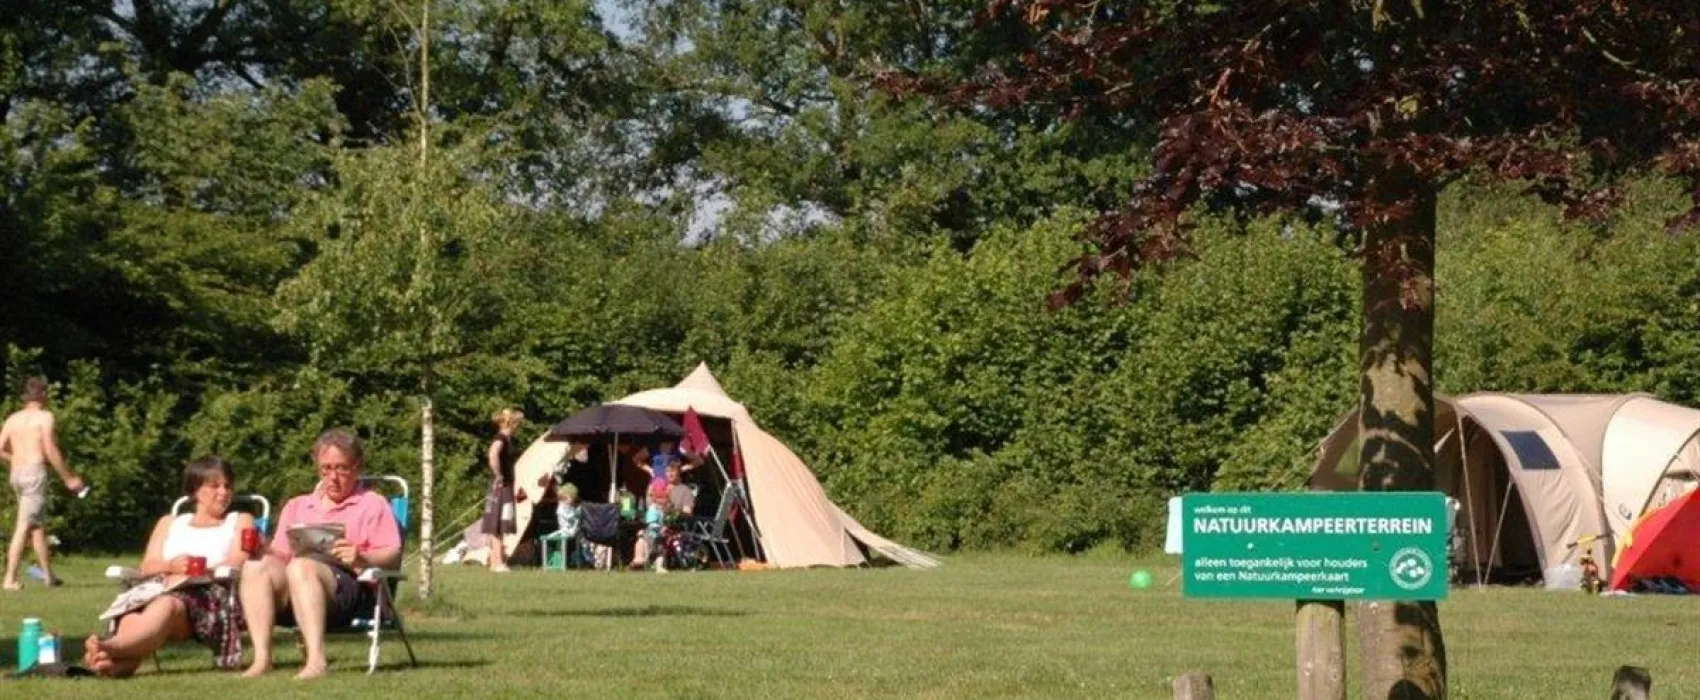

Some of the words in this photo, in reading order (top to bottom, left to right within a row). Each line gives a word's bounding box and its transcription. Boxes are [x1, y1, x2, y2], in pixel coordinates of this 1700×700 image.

[1193, 517, 1432, 534] NATUURKAMPEERTERREIN
[1195, 557, 1227, 568] alleen
[1229, 557, 1294, 570] toegankelijk
[1297, 560, 1321, 568] voor
[1324, 557, 1367, 568] houders
[1194, 572, 1214, 581] van
[1216, 572, 1236, 581] een
[1238, 570, 1349, 584] Natuurkampeerkaart
